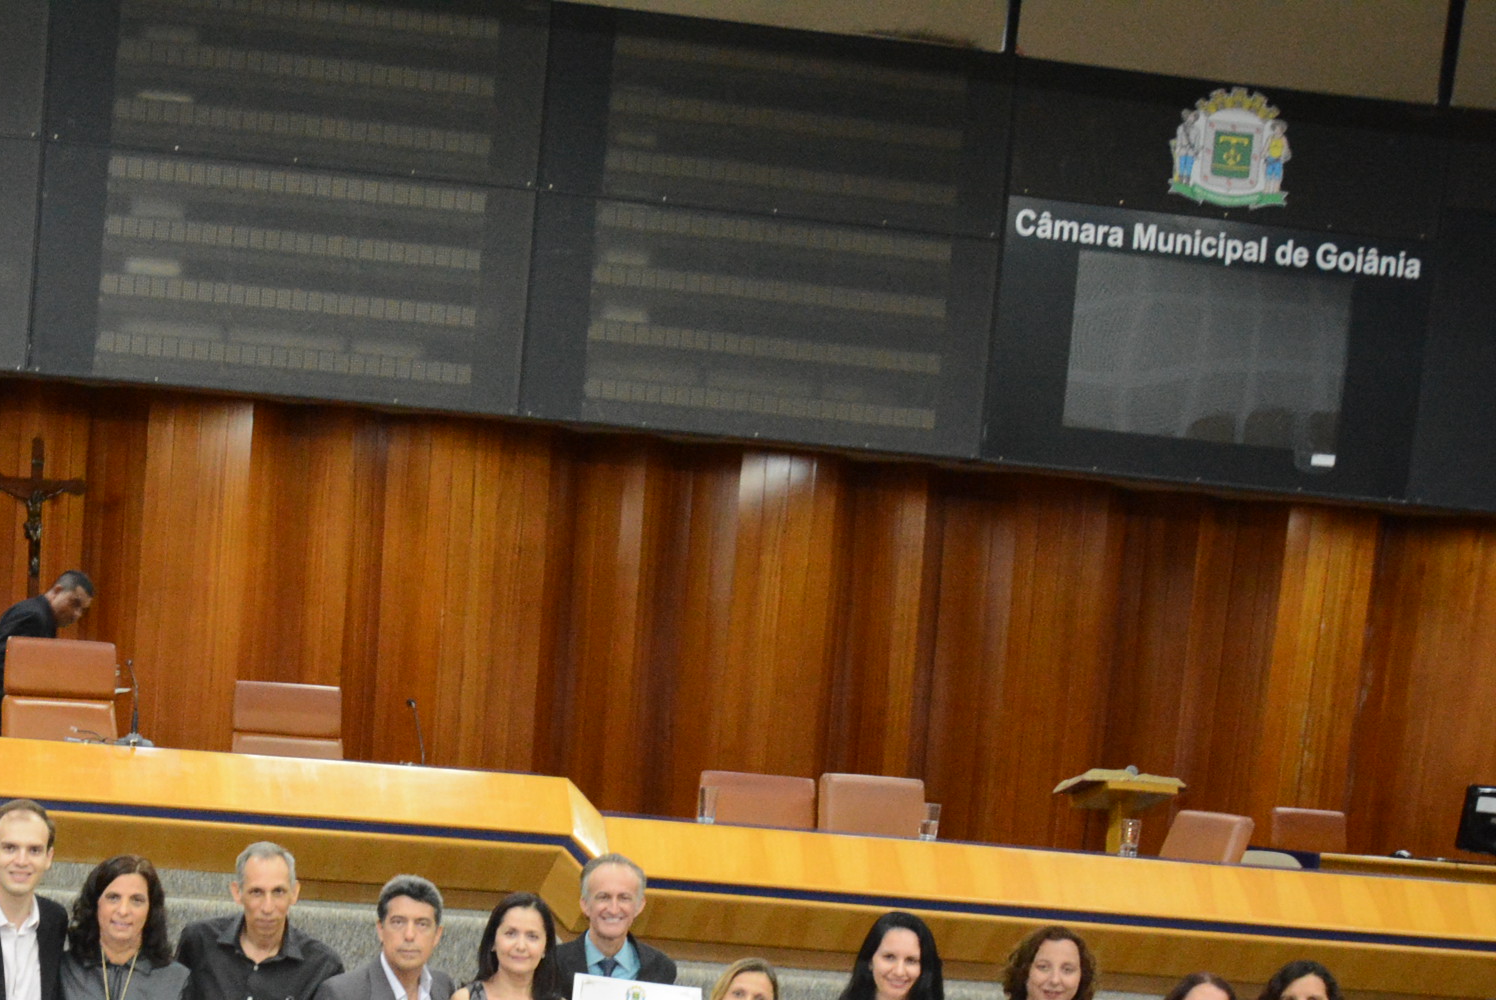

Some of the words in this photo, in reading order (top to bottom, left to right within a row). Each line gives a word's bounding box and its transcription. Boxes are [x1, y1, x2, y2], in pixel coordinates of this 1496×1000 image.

[1015, 208, 1124, 248] Câmara
[1132, 222, 1268, 266] Municipal
[1275, 239, 1309, 268] de
[1316, 242, 1421, 280] Goiânia
